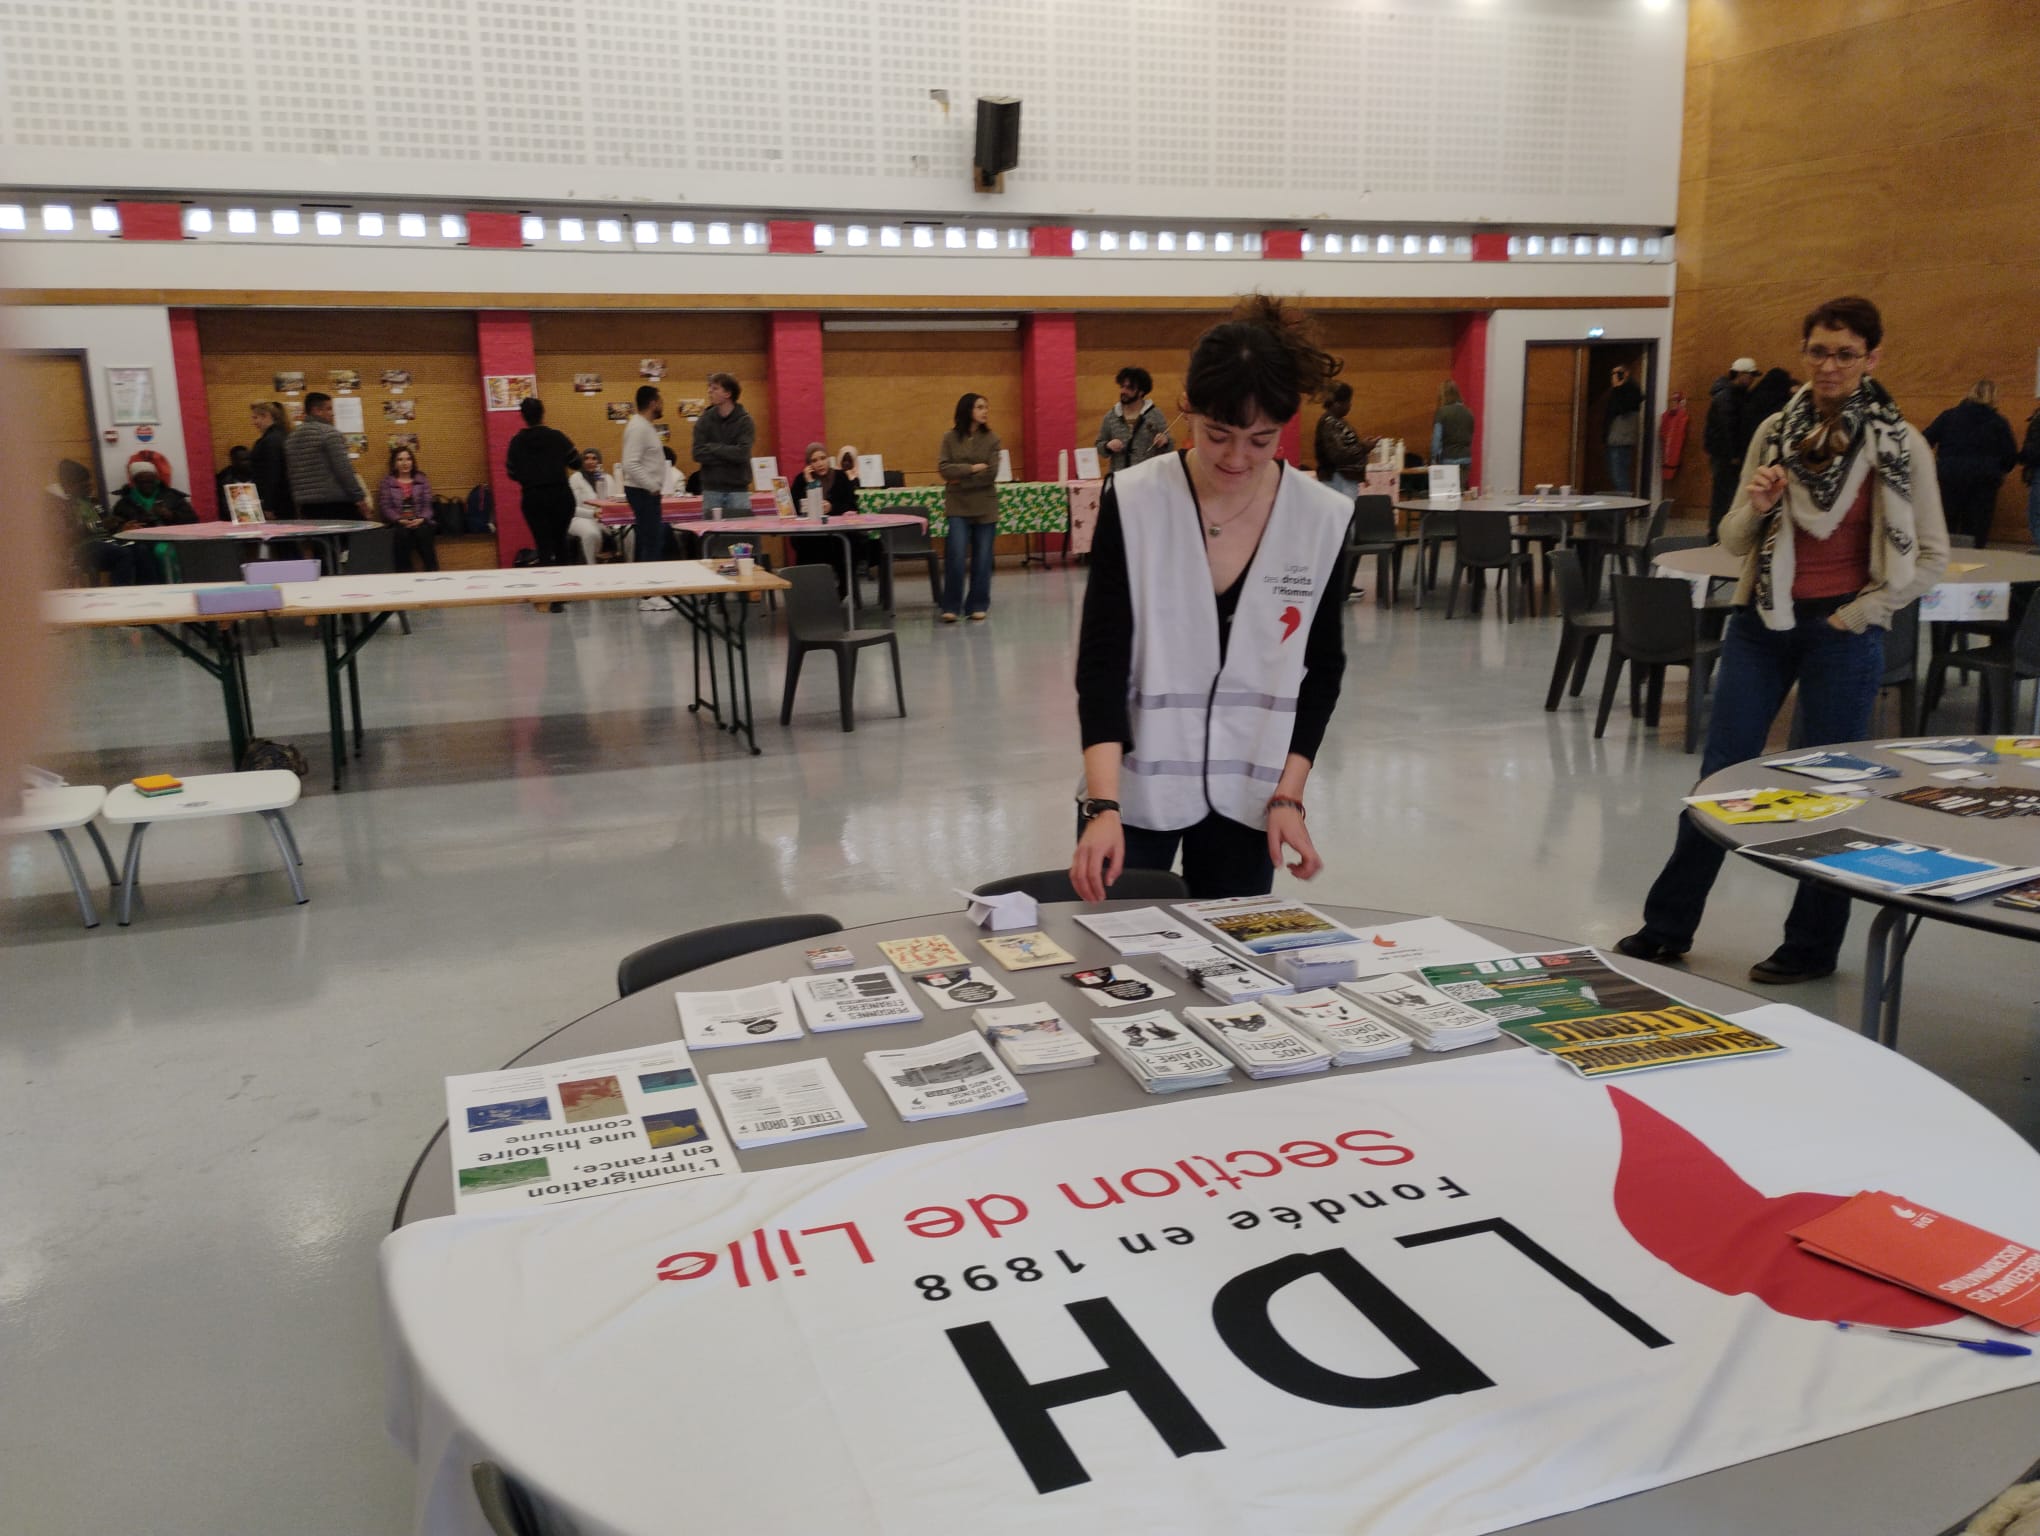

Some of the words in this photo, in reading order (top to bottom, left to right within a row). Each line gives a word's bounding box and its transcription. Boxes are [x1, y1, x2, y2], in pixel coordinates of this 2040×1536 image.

[1238, 1037, 1297, 1051] DROITS
[1356, 1032, 1391, 1044] NOS
[1156, 1050, 1202, 1063] FAIRE
[1272, 1046, 1308, 1059] NOS
[1559, 1031, 1773, 1070] ISLAMOPHOBIE
[1180, 1058, 1214, 1071] QUE
[506, 1119, 633, 1144] commune
[754, 1118, 788, 1132] DROIT
[790, 1116, 805, 1126] DE
[589, 1130, 637, 1146] une
[478, 1140, 580, 1162] histoire
[683, 1145, 714, 1157] en
[573, 1152, 675, 1174] France,
[1058, 1129, 1416, 1210] Section
[528, 1158, 720, 1198] L'immigration
[1229, 1174, 1471, 1232] Fondée
[905, 1192, 1030, 1240] de
[1122, 1225, 1196, 1256] en
[656, 1220, 877, 1288] Lille
[914, 1248, 1086, 1302] 1898
[944, 1216, 1675, 1495] LDH
